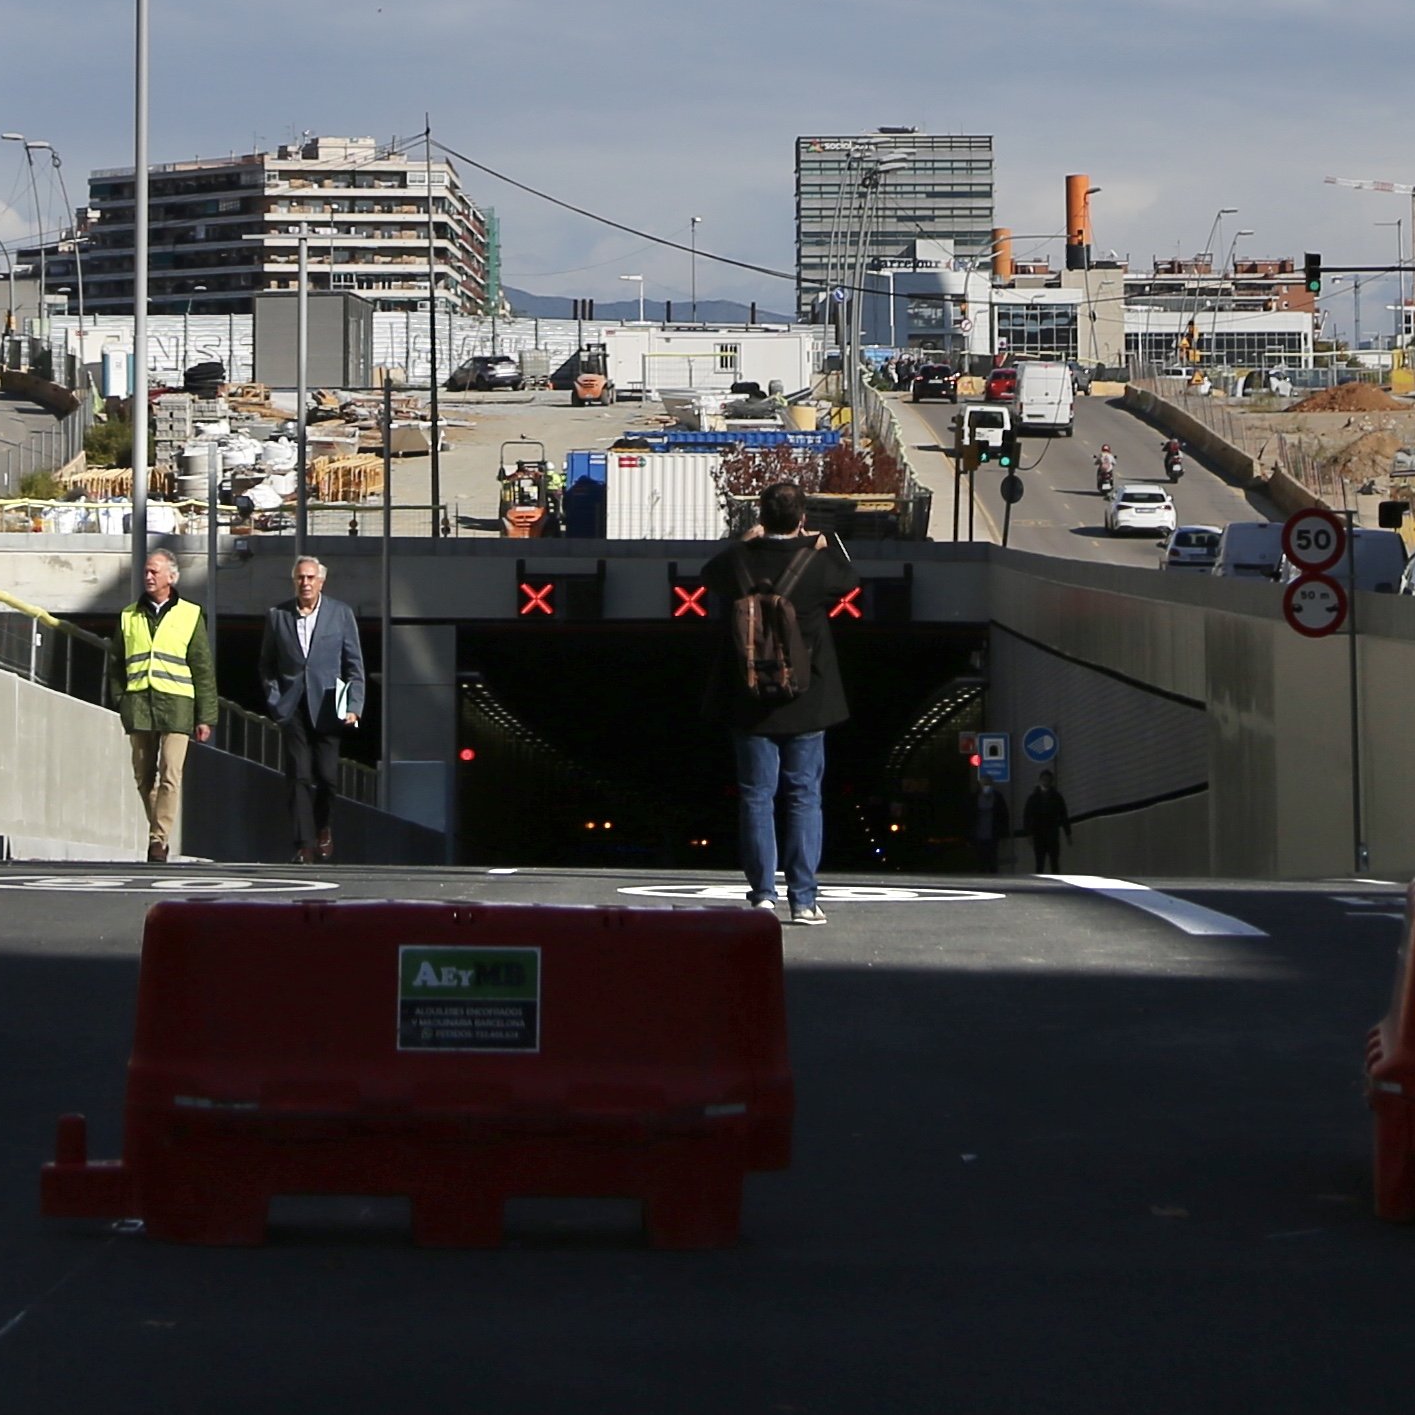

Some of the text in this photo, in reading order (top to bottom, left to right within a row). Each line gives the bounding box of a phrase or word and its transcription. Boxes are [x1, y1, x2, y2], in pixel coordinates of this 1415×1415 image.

[1297, 529, 1331, 551] 50
[1301, 590, 1330, 600] 50 m
